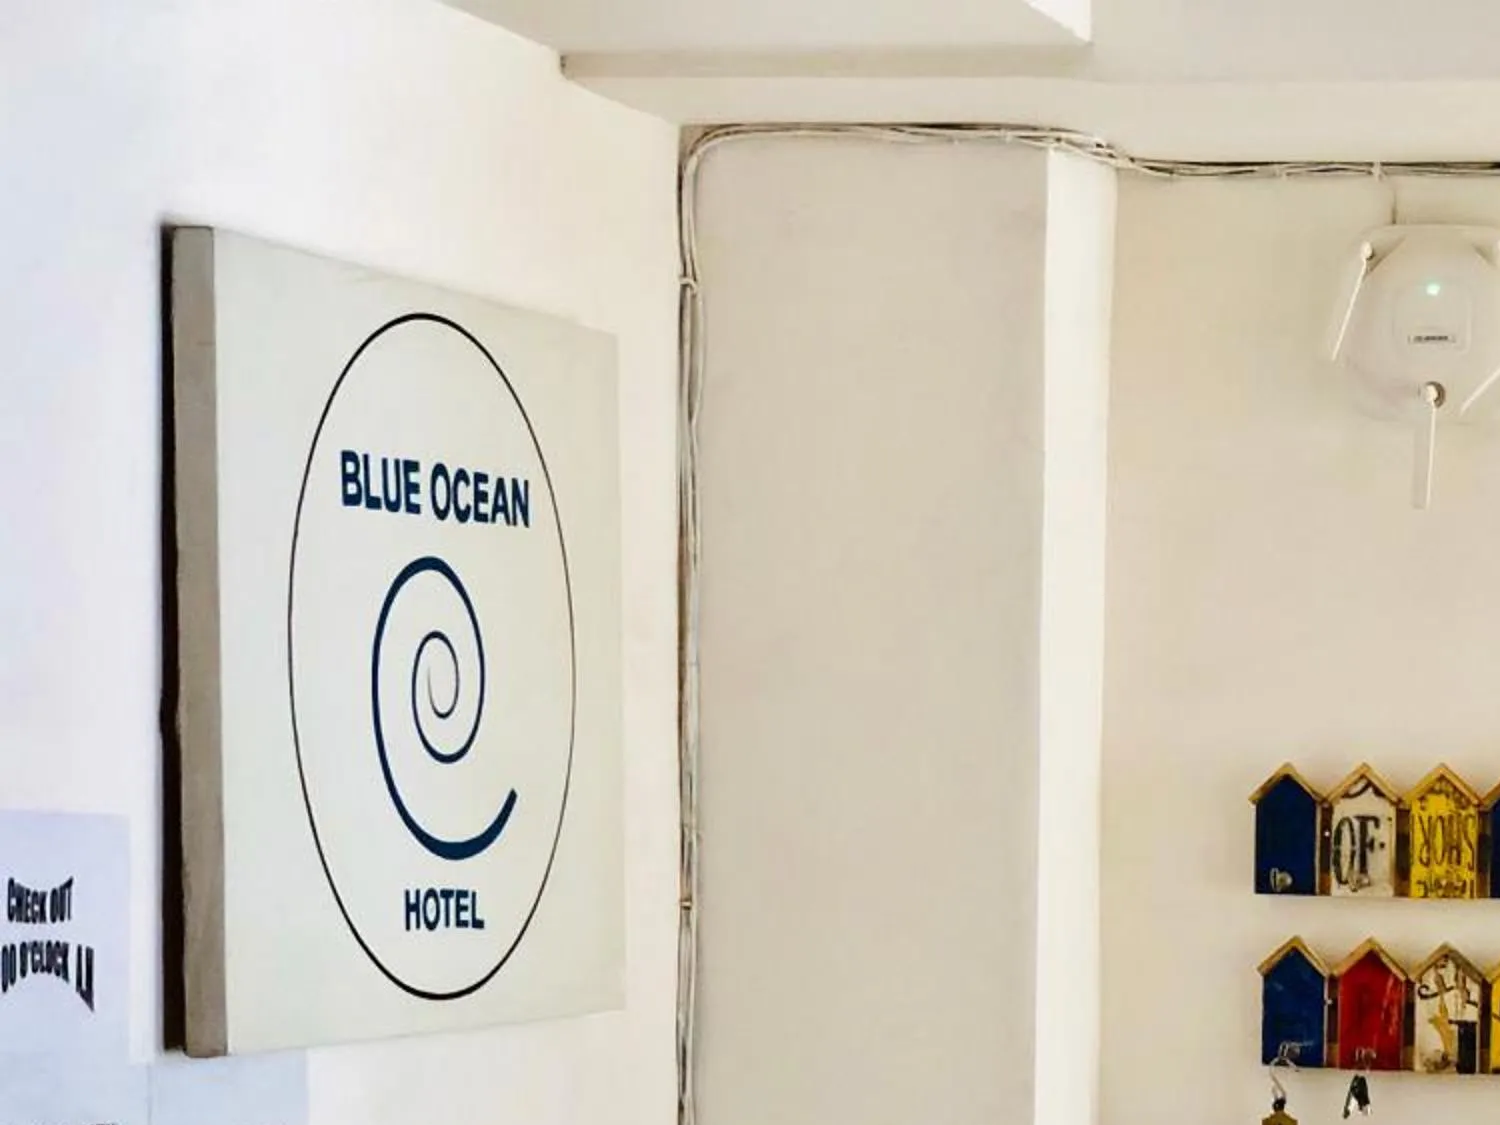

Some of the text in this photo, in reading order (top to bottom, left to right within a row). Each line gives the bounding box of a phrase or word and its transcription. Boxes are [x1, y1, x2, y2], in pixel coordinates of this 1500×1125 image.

[341, 450, 530, 528] BLUE OCEAN
[7, 875, 74, 924] CHECK OUT
[405, 887, 485, 931] HOTEL
